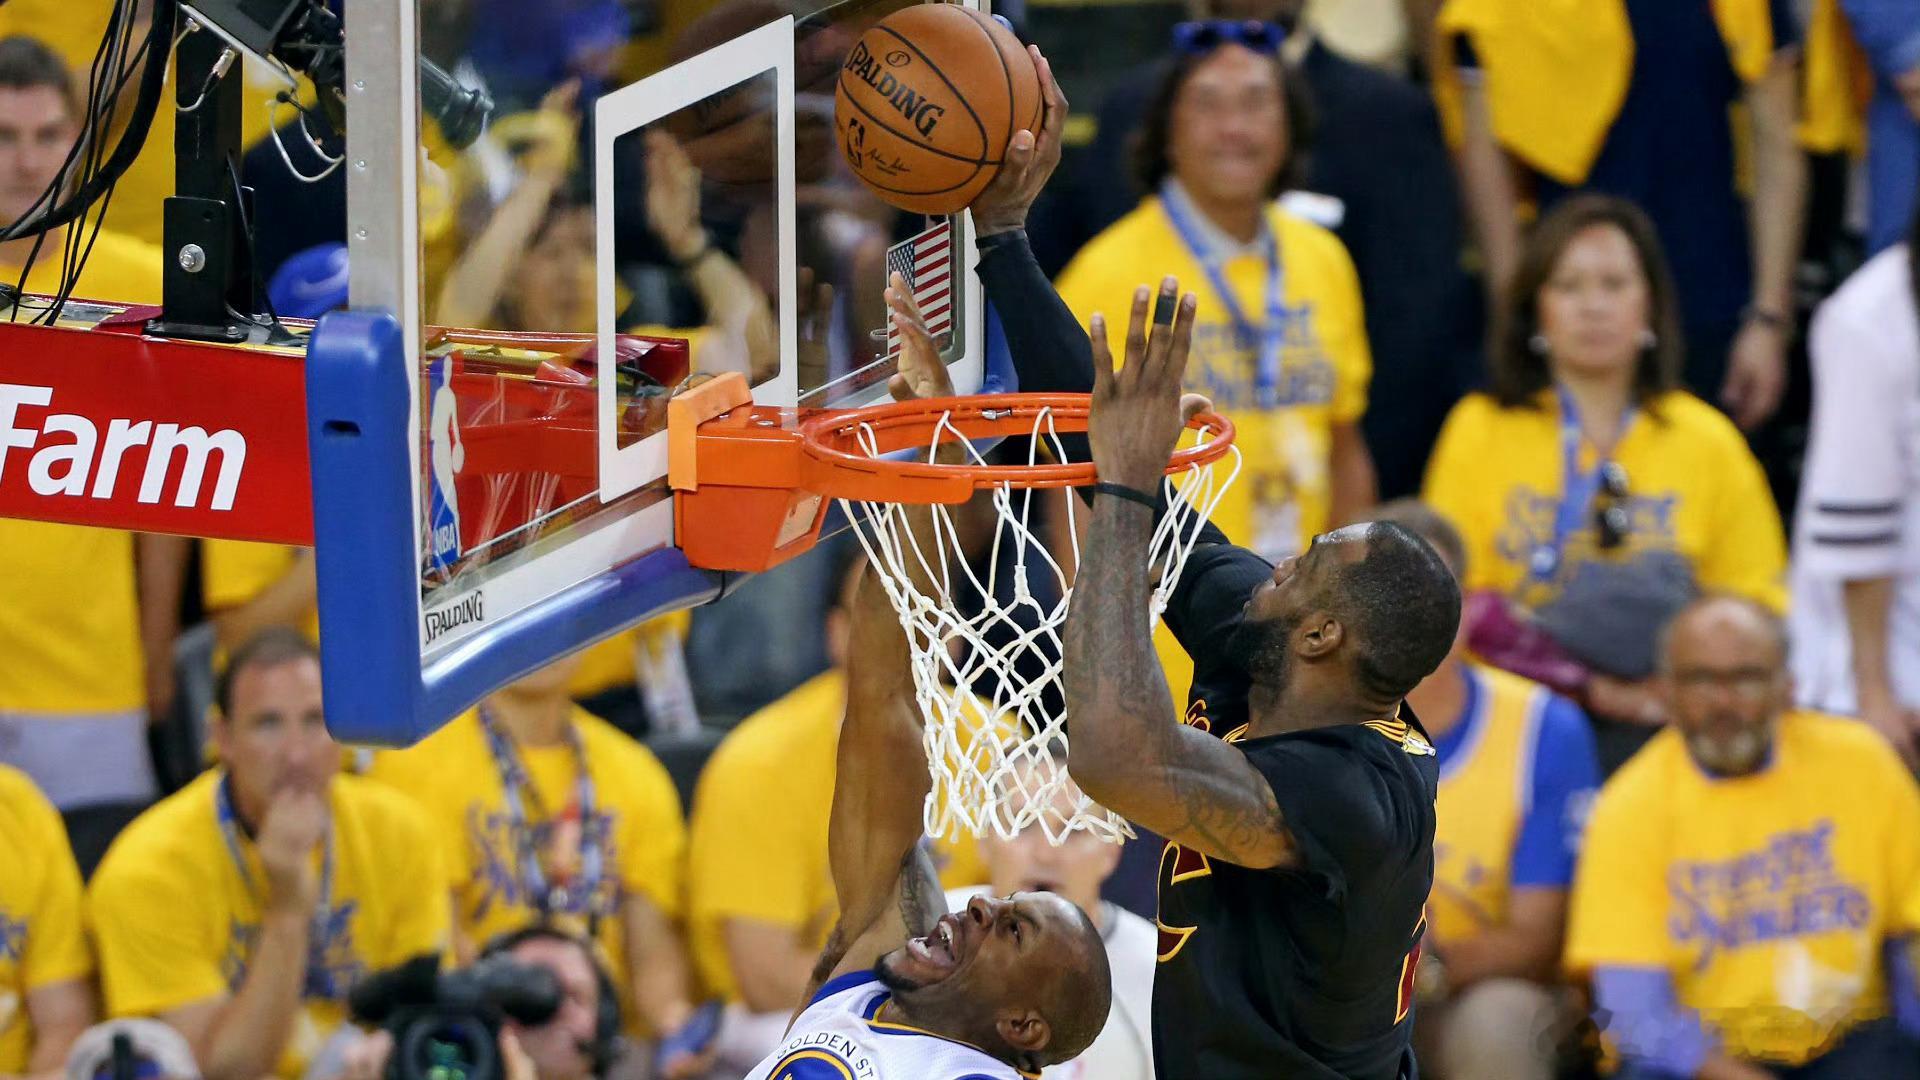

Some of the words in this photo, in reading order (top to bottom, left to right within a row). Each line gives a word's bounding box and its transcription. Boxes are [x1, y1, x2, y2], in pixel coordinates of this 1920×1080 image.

[844, 41, 945, 137] SPALDING
[0, 383, 247, 511] Farm
[435, 522, 456, 555] NBA
[425, 590, 483, 645] SPALDING
